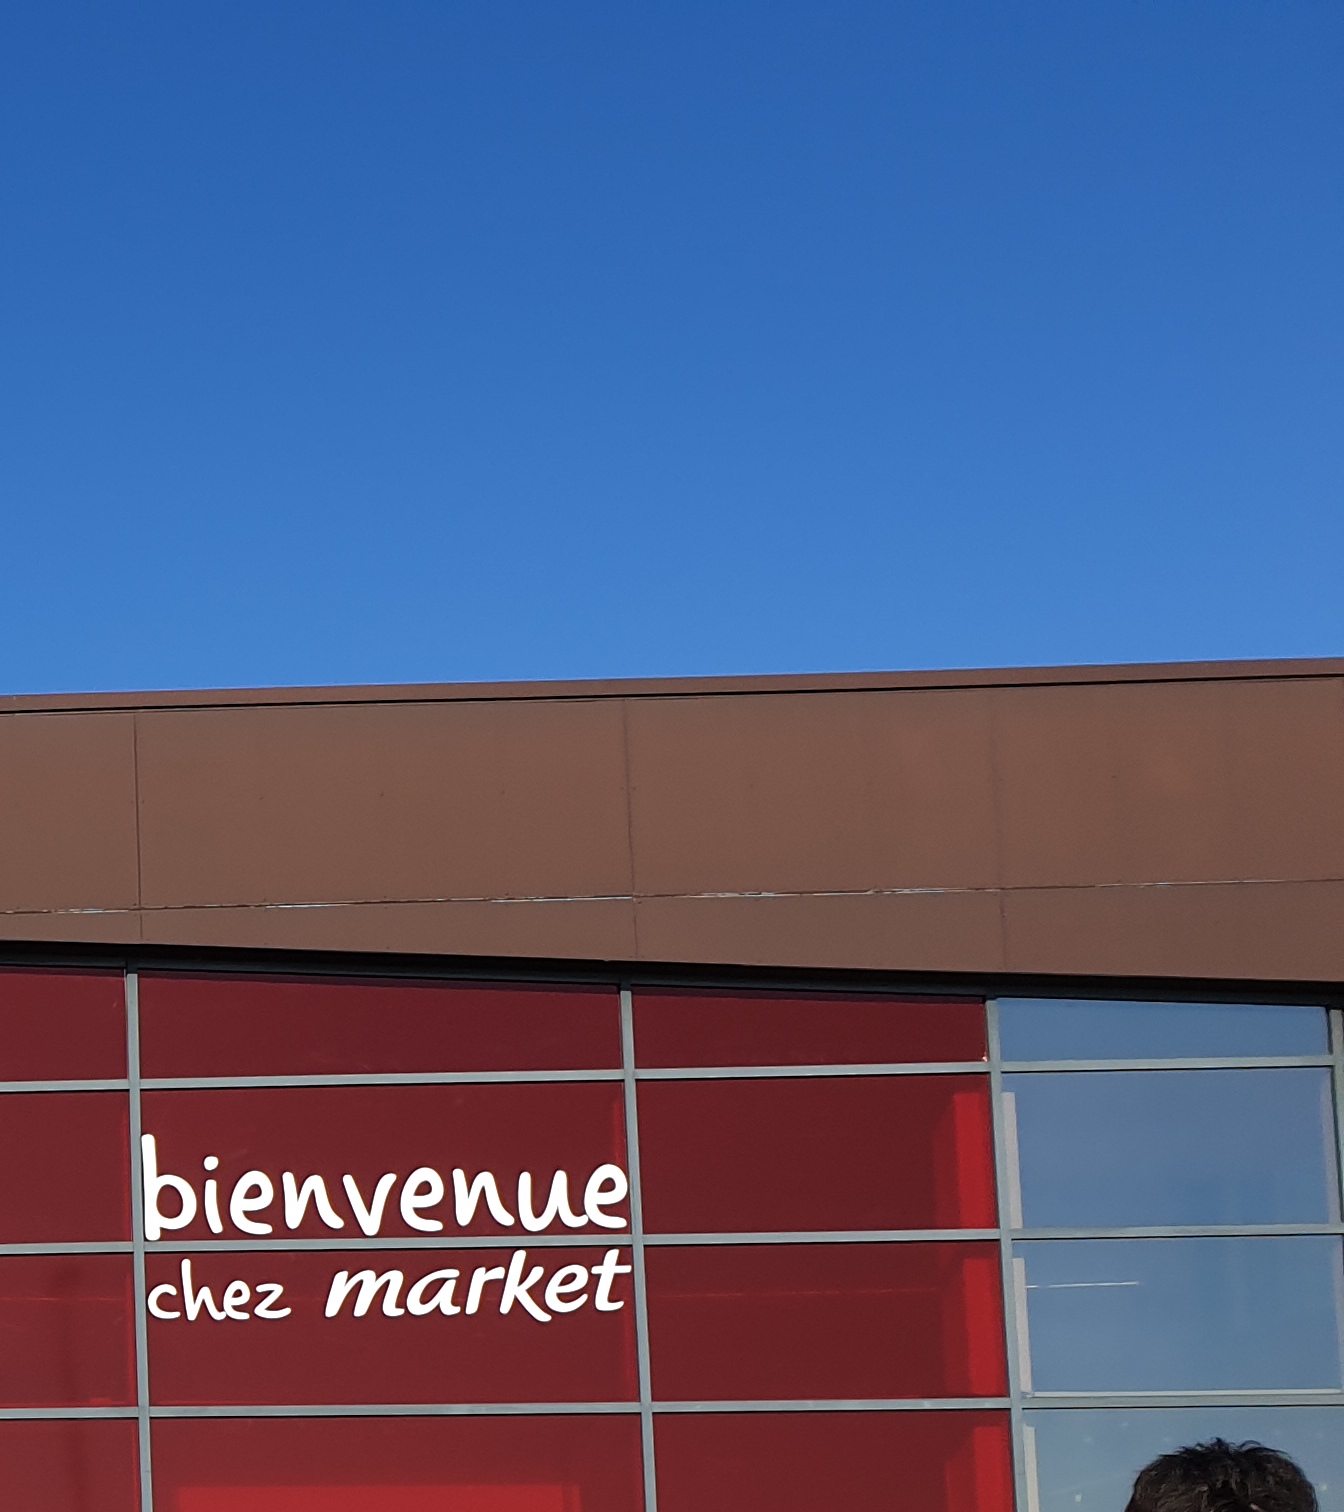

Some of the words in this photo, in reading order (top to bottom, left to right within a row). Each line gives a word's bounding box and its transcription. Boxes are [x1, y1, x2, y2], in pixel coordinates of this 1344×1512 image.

[141, 1133, 629, 1241] bienvenue
[147, 1259, 292, 1321] chez
[324, 1249, 632, 1322] market
